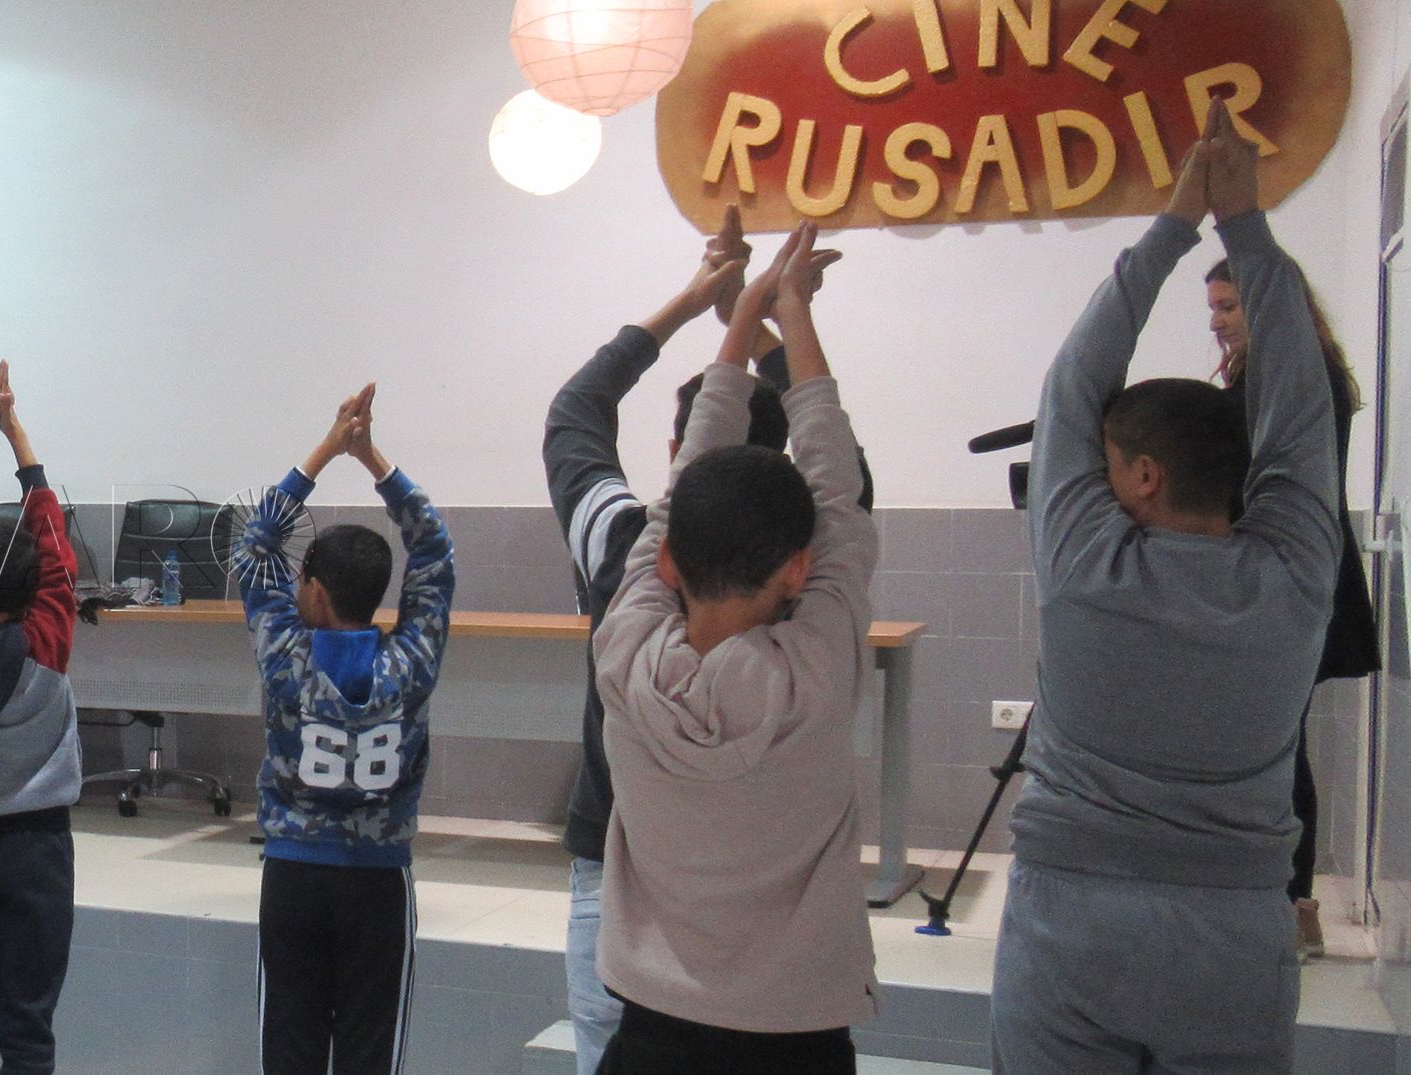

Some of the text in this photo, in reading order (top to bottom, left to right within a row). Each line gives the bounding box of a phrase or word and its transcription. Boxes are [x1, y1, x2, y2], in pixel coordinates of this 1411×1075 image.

[823, 0, 1168, 98] CINE
[701, 62, 1282, 218] RUSADIR
[298, 722, 403, 791] 68
